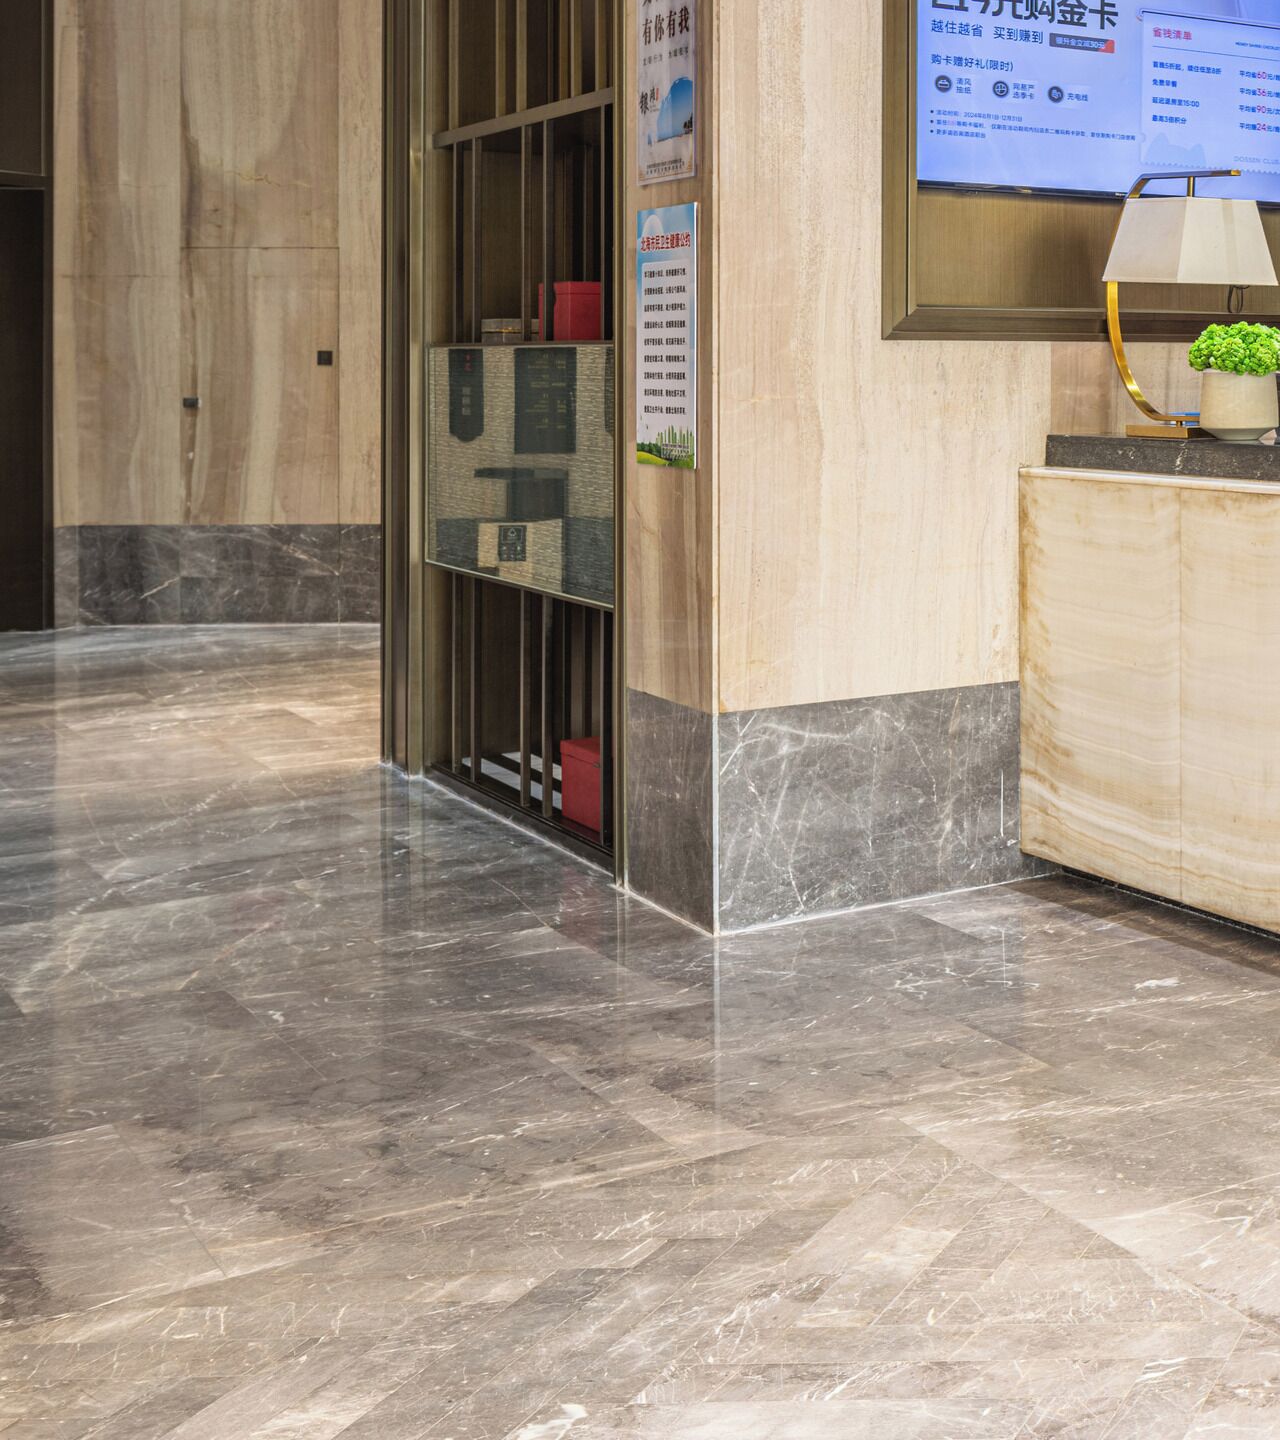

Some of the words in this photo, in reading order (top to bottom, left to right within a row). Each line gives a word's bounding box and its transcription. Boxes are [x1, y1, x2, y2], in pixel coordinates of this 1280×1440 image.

[642, 6, 690, 47] 有你有我
[930, 18, 983, 38] 越住越省
[992, 24, 1044, 45] 买到赚到
[1152, 25, 1192, 42] 省钱清单
[930, 53, 1014, 73] 购卡赠好礼(限时)
[640, 230, 691, 253] 北海市民卫生健康公约
